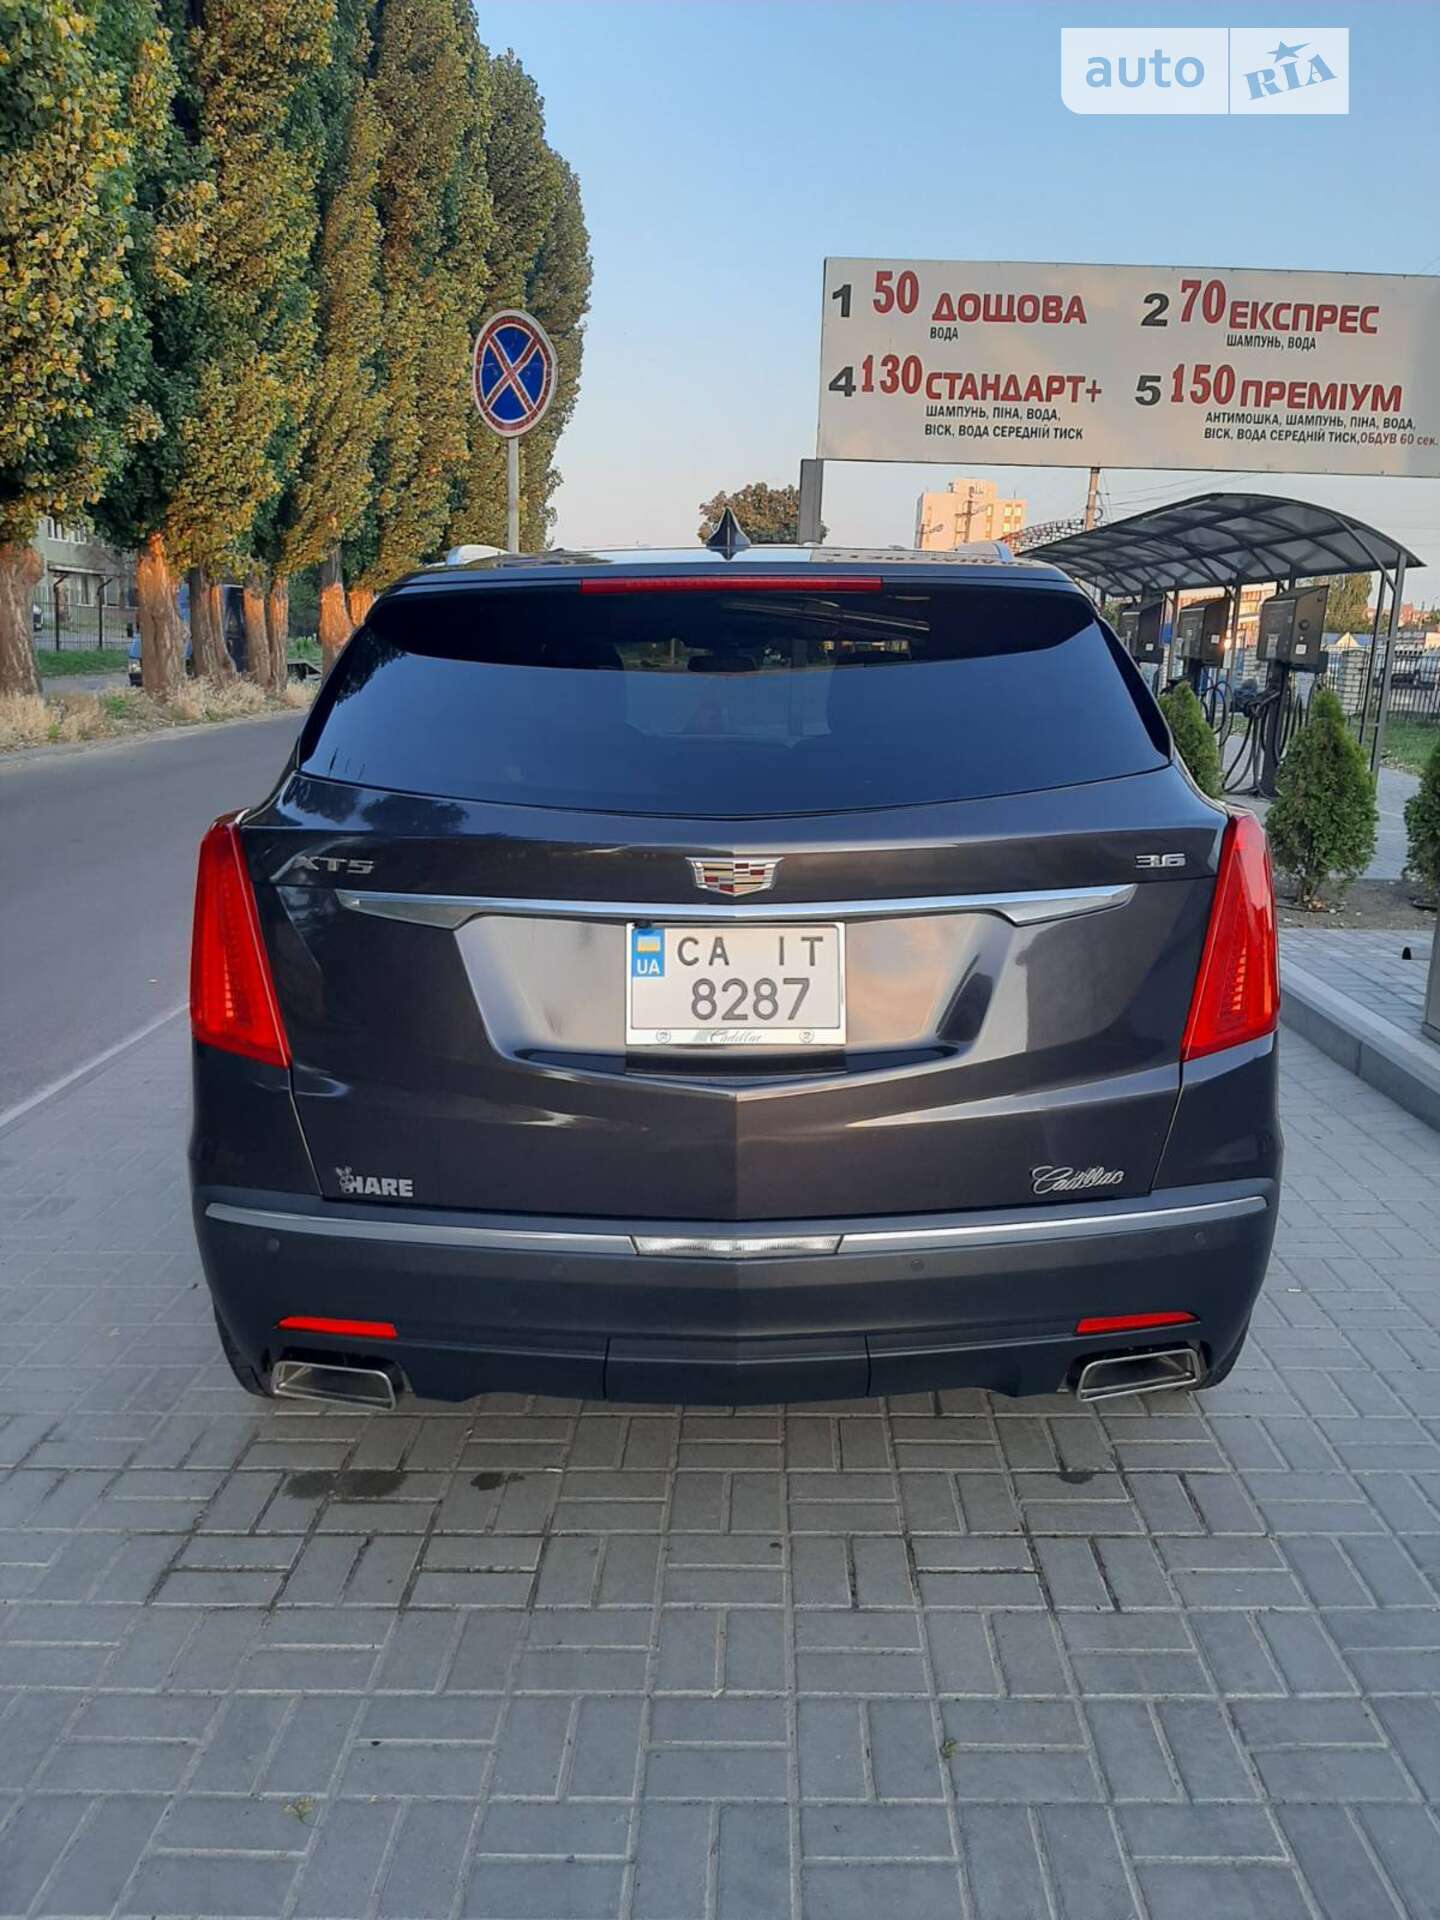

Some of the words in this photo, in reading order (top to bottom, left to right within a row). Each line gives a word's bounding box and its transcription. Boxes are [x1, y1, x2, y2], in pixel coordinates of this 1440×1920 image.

[832, 284, 852, 317] 1
[873, 271, 919, 313] 50
[932, 293, 1087, 324] ДОШОВА
[1140, 293, 1170, 327] 2
[1180, 279, 1226, 324] 70
[1229, 301, 1380, 334] ЕКСПРЕС
[930, 327, 958, 341] ВОДА
[1227, 334, 1284, 349] ШАМПУНЬ,
[1287, 336, 1317, 350] ВОДА
[828, 366, 856, 397] 4
[861, 354, 922, 394] 130
[1135, 375, 1161, 405] 5
[1171, 364, 1235, 405] 150
[1240, 380, 1402, 412] ПРЕМІУМ
[926, 405, 989, 420] ШАМПУНЬ,
[958, 425, 989, 438] ВОДА
[993, 425, 1050, 440] СЕРЕДНІЙ
[1053, 427, 1083, 440] ТИСК
[1237, 429, 1267, 442] ВОДА
[1400, 436, 1414, 446] 60
[677, 936, 730, 967] CA
[778, 936, 824, 967] IT
[637, 959, 661, 975] UA
[691, 977, 810, 1021] 8287
[1032, 1165, 1124, 1194] Cadillac
